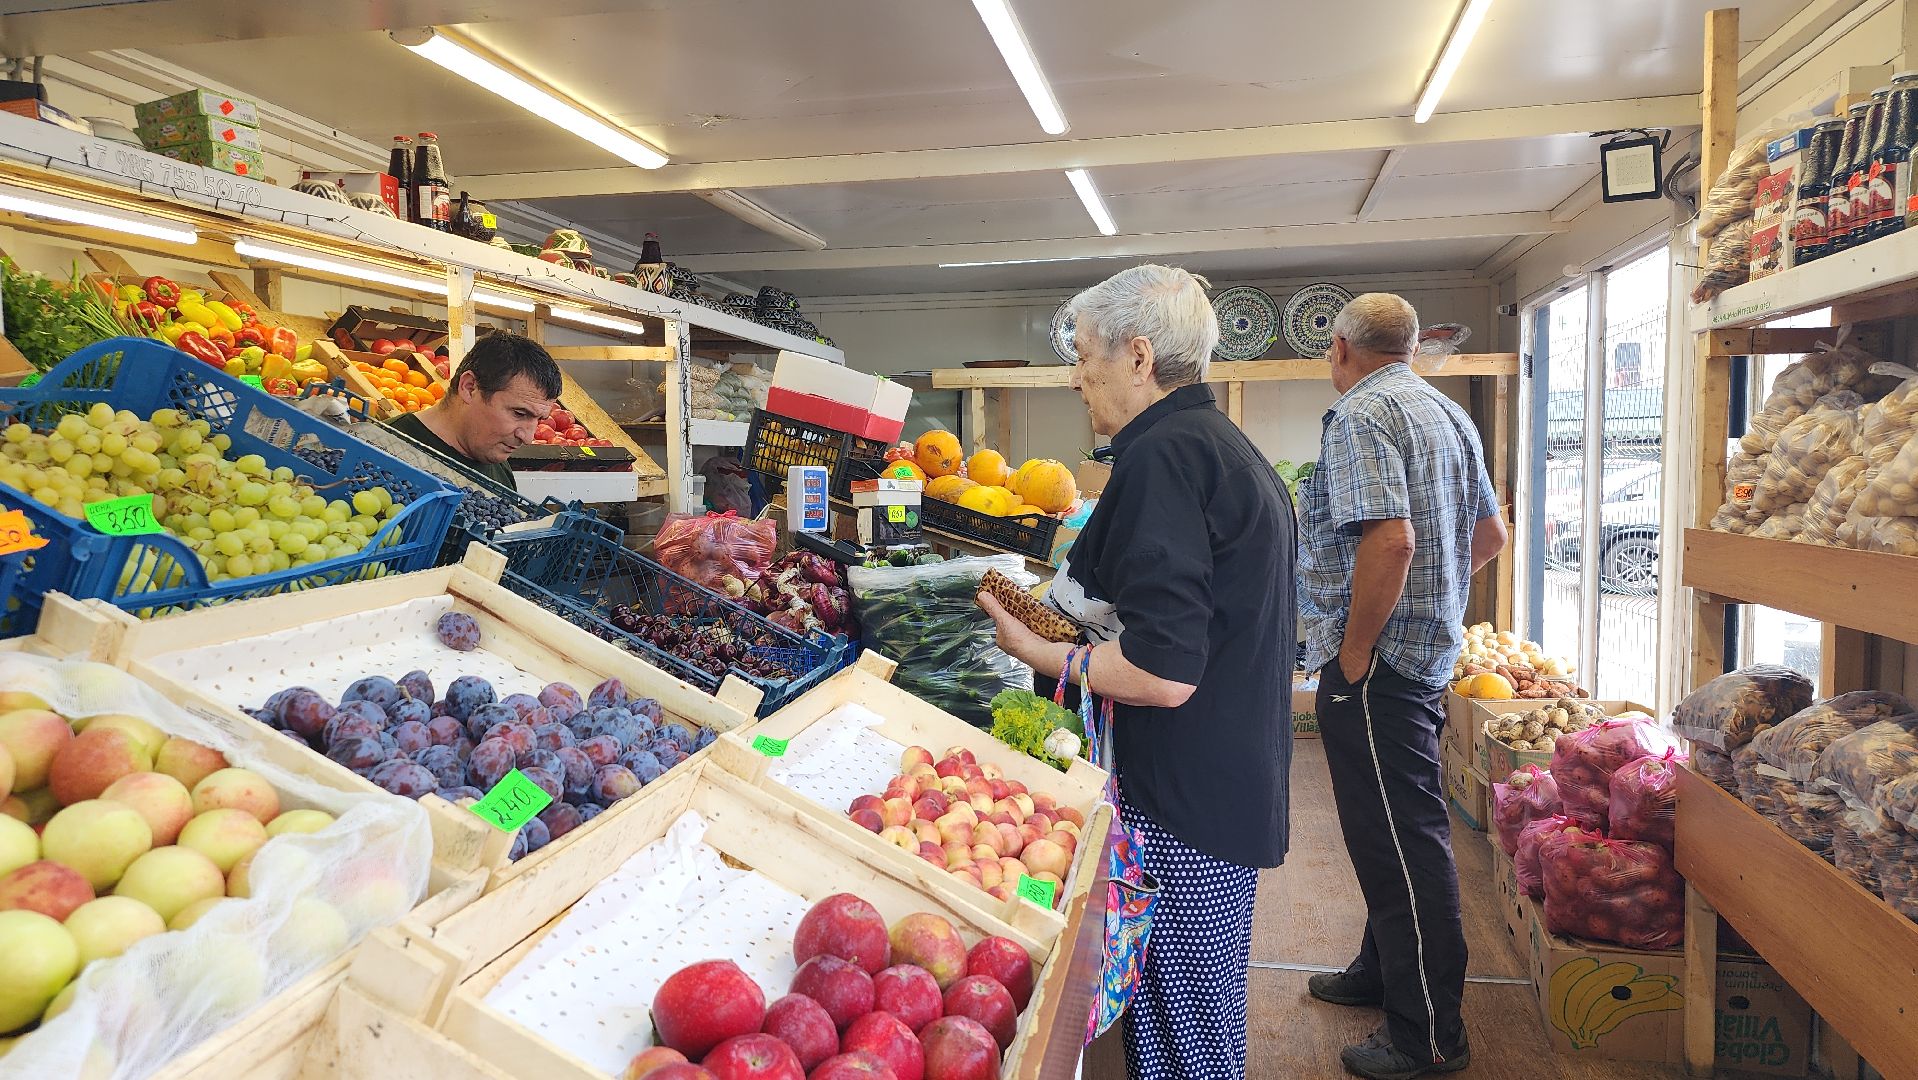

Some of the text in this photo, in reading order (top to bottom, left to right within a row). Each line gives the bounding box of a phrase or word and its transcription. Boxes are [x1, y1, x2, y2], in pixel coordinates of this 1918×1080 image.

[1292, 711, 1318, 721] Globa
[1292, 721, 1320, 733] Villag
[1716, 1041, 1790, 1066] Globa
